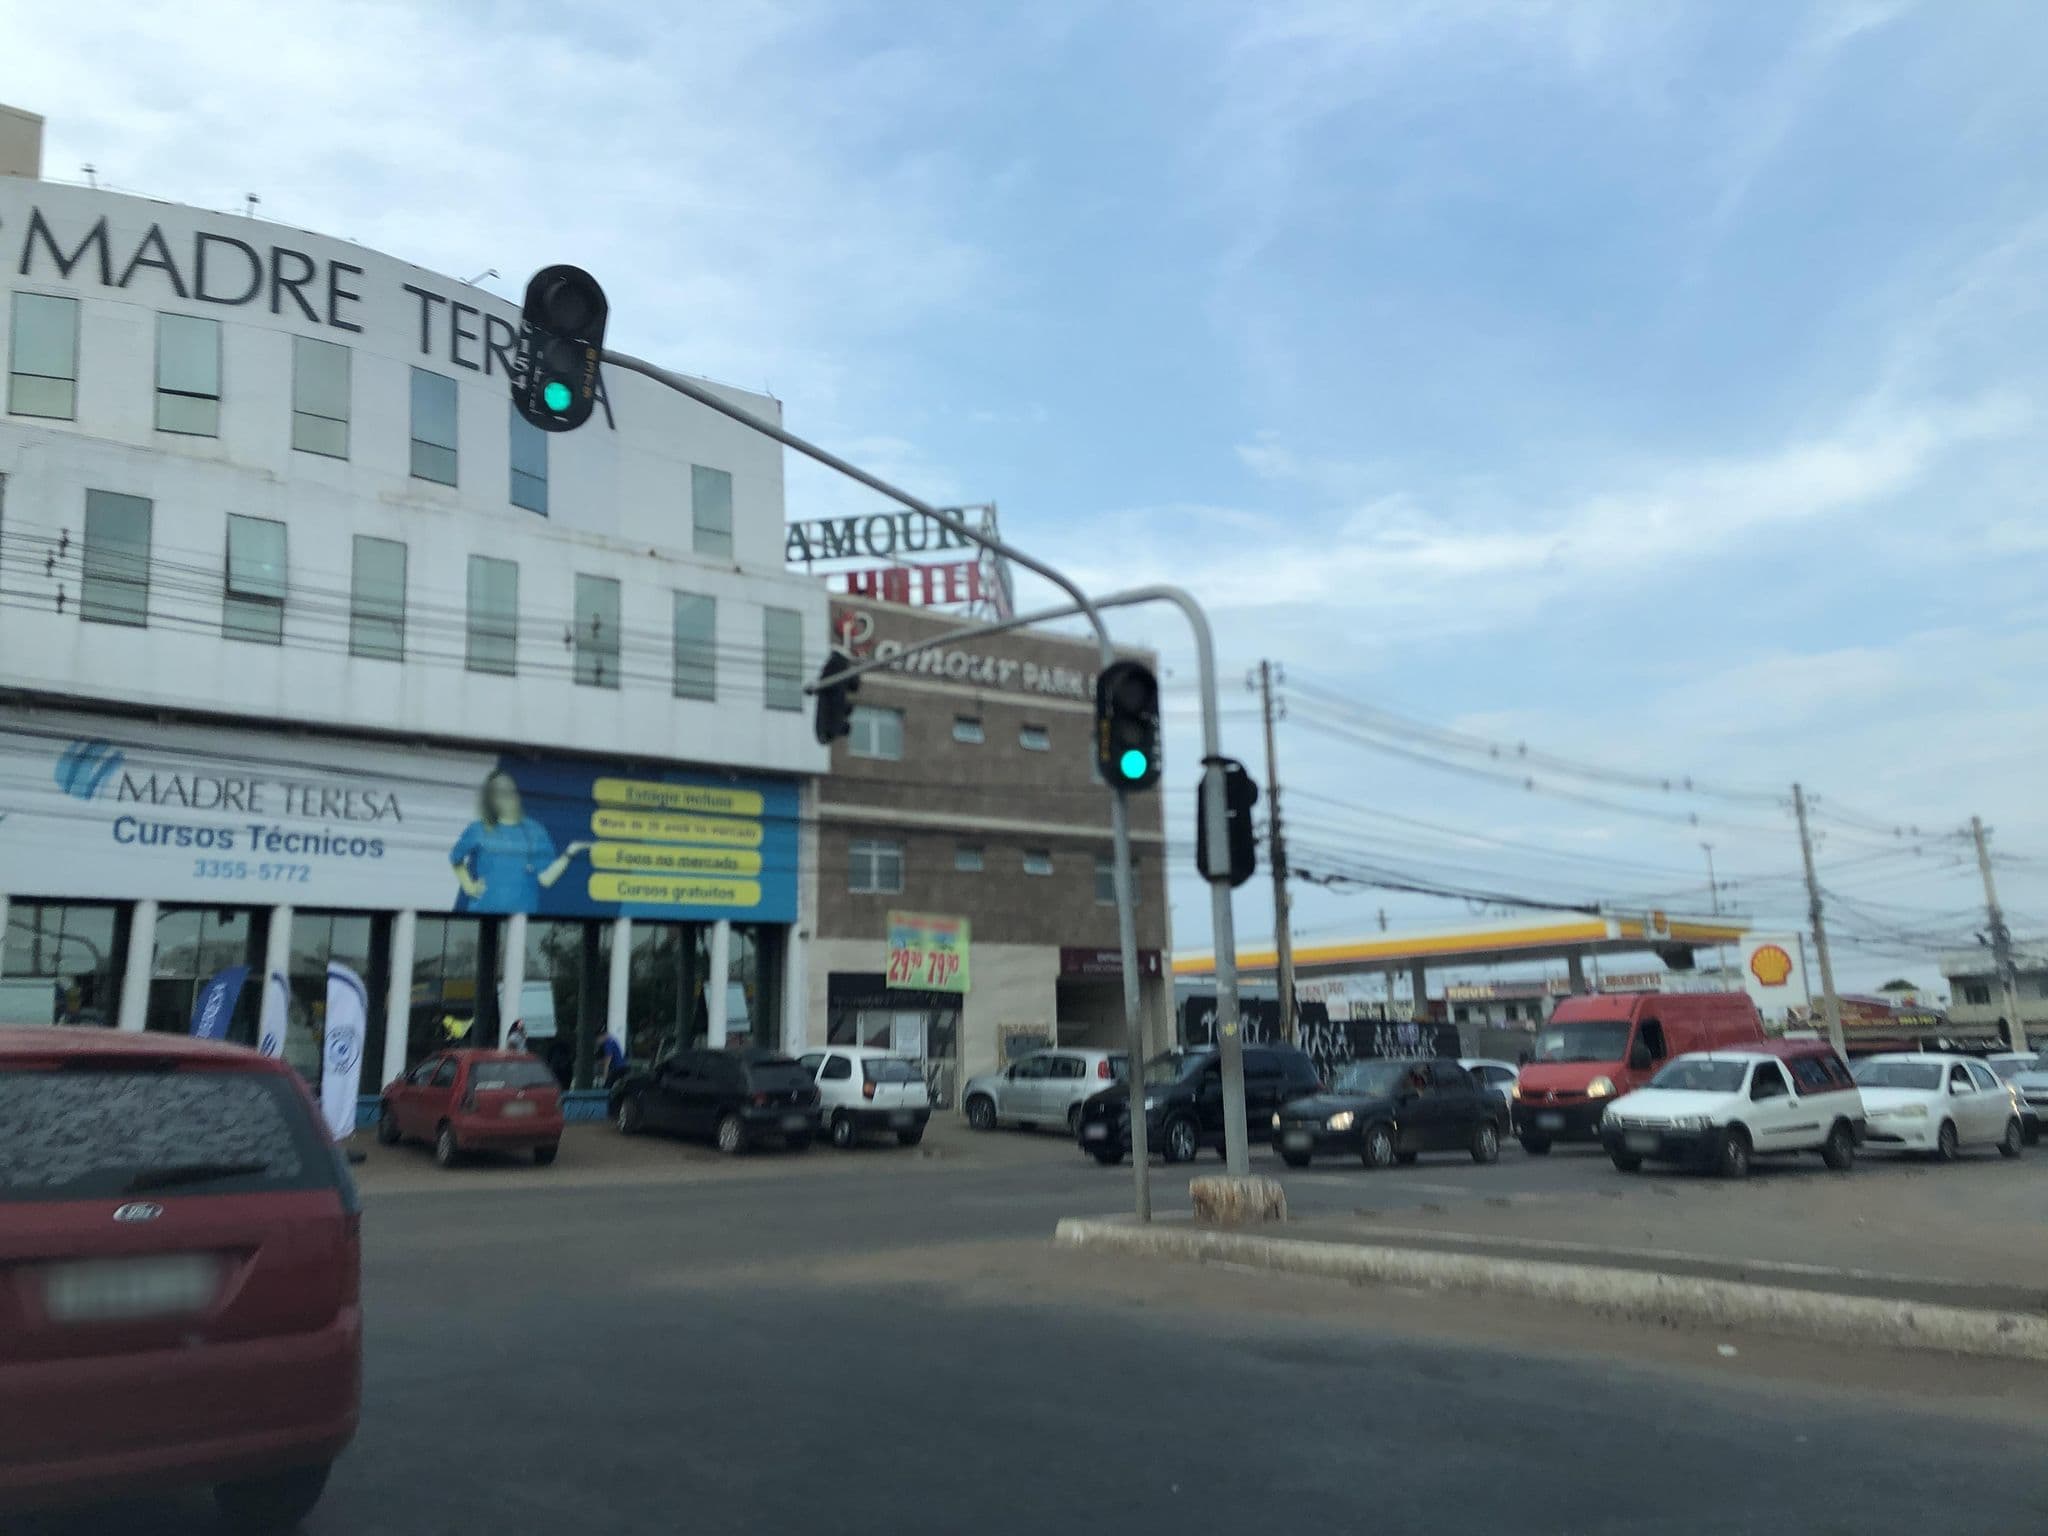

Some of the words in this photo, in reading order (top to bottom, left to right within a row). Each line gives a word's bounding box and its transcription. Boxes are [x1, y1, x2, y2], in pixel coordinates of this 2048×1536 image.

[20, 205, 364, 335] MADRE
[403, 283, 617, 432] TERA
[117, 769, 264, 814] MADRE
[279, 781, 403, 823] TERESA
[113, 815, 233, 850] Cursos
[246, 824, 384, 859] Técnicos
[616, 880, 668, 897] Cursos
[671, 884, 736, 901] gratuitos
